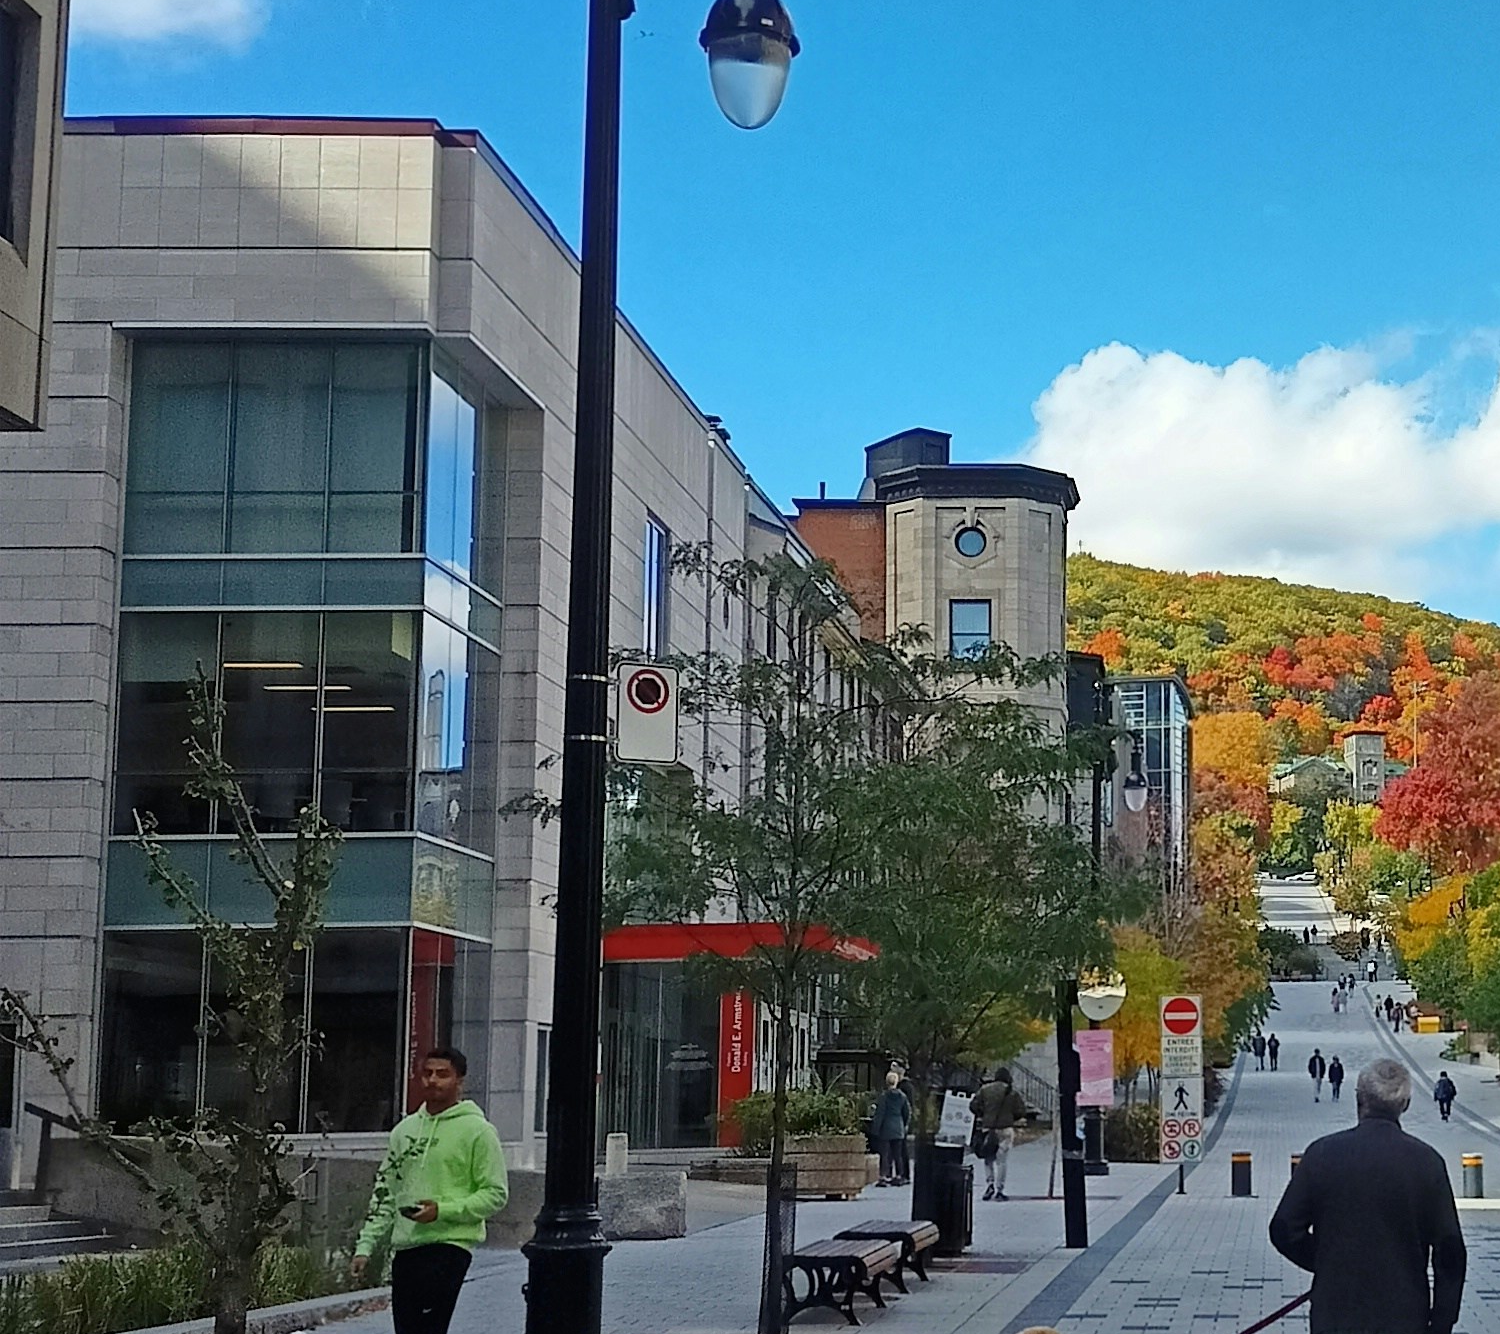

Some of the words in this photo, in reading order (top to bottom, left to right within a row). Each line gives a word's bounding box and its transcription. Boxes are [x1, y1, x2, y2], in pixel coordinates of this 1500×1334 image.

[732, 1031, 741, 1041] E.
[1163, 1046, 1199, 1054] INTERDITE
[731, 1042, 741, 1073] Donald
